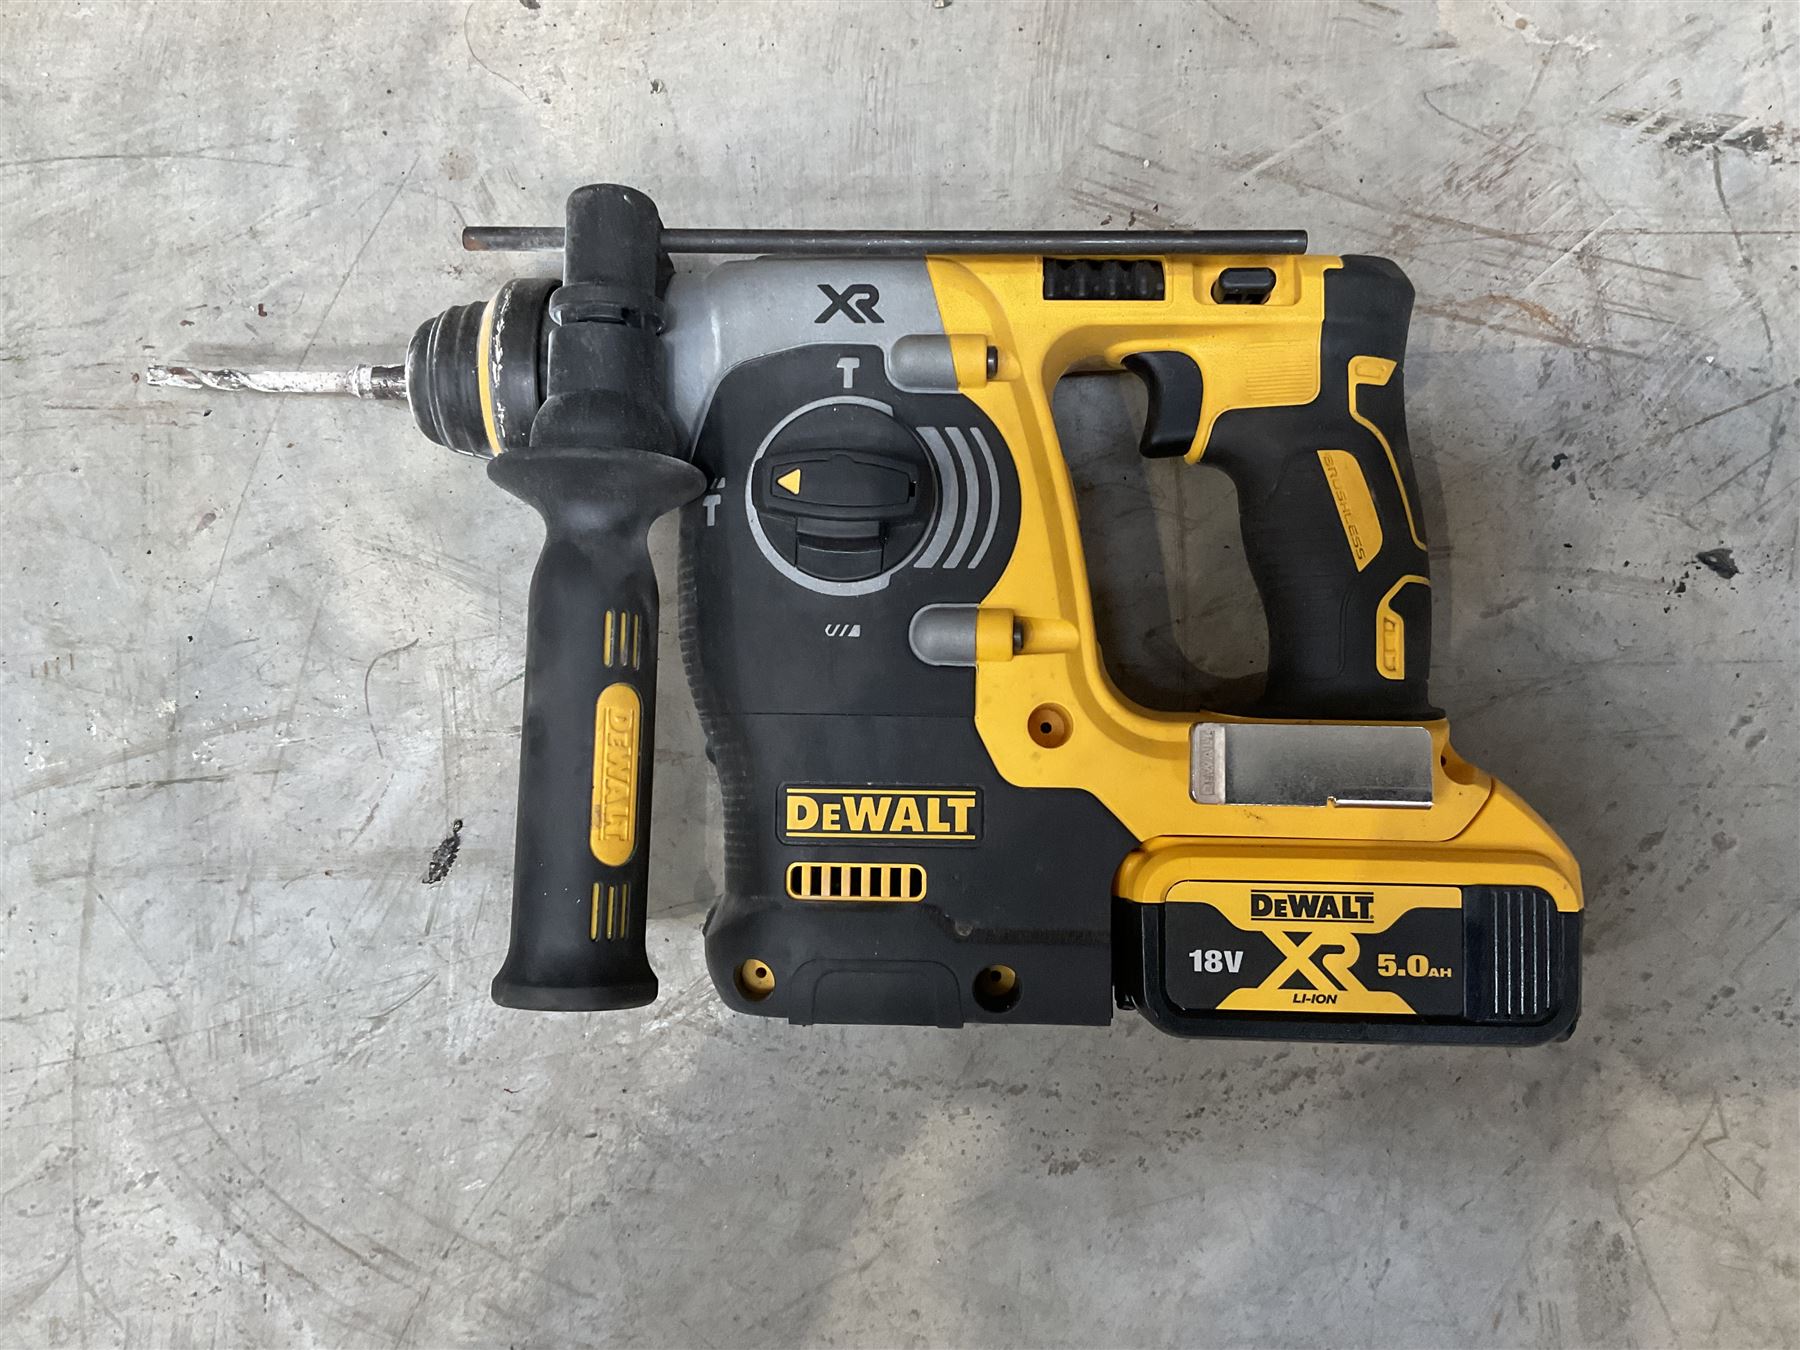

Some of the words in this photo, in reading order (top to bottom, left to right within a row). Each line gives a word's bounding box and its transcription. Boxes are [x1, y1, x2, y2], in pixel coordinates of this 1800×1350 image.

[814, 284, 885, 324] XR
[1323, 452, 1366, 561] BRUSHLESS
[1189, 949, 1244, 973] 18V
[1258, 931, 1368, 991] XR
[1292, 993, 1338, 1004] LI-ION
